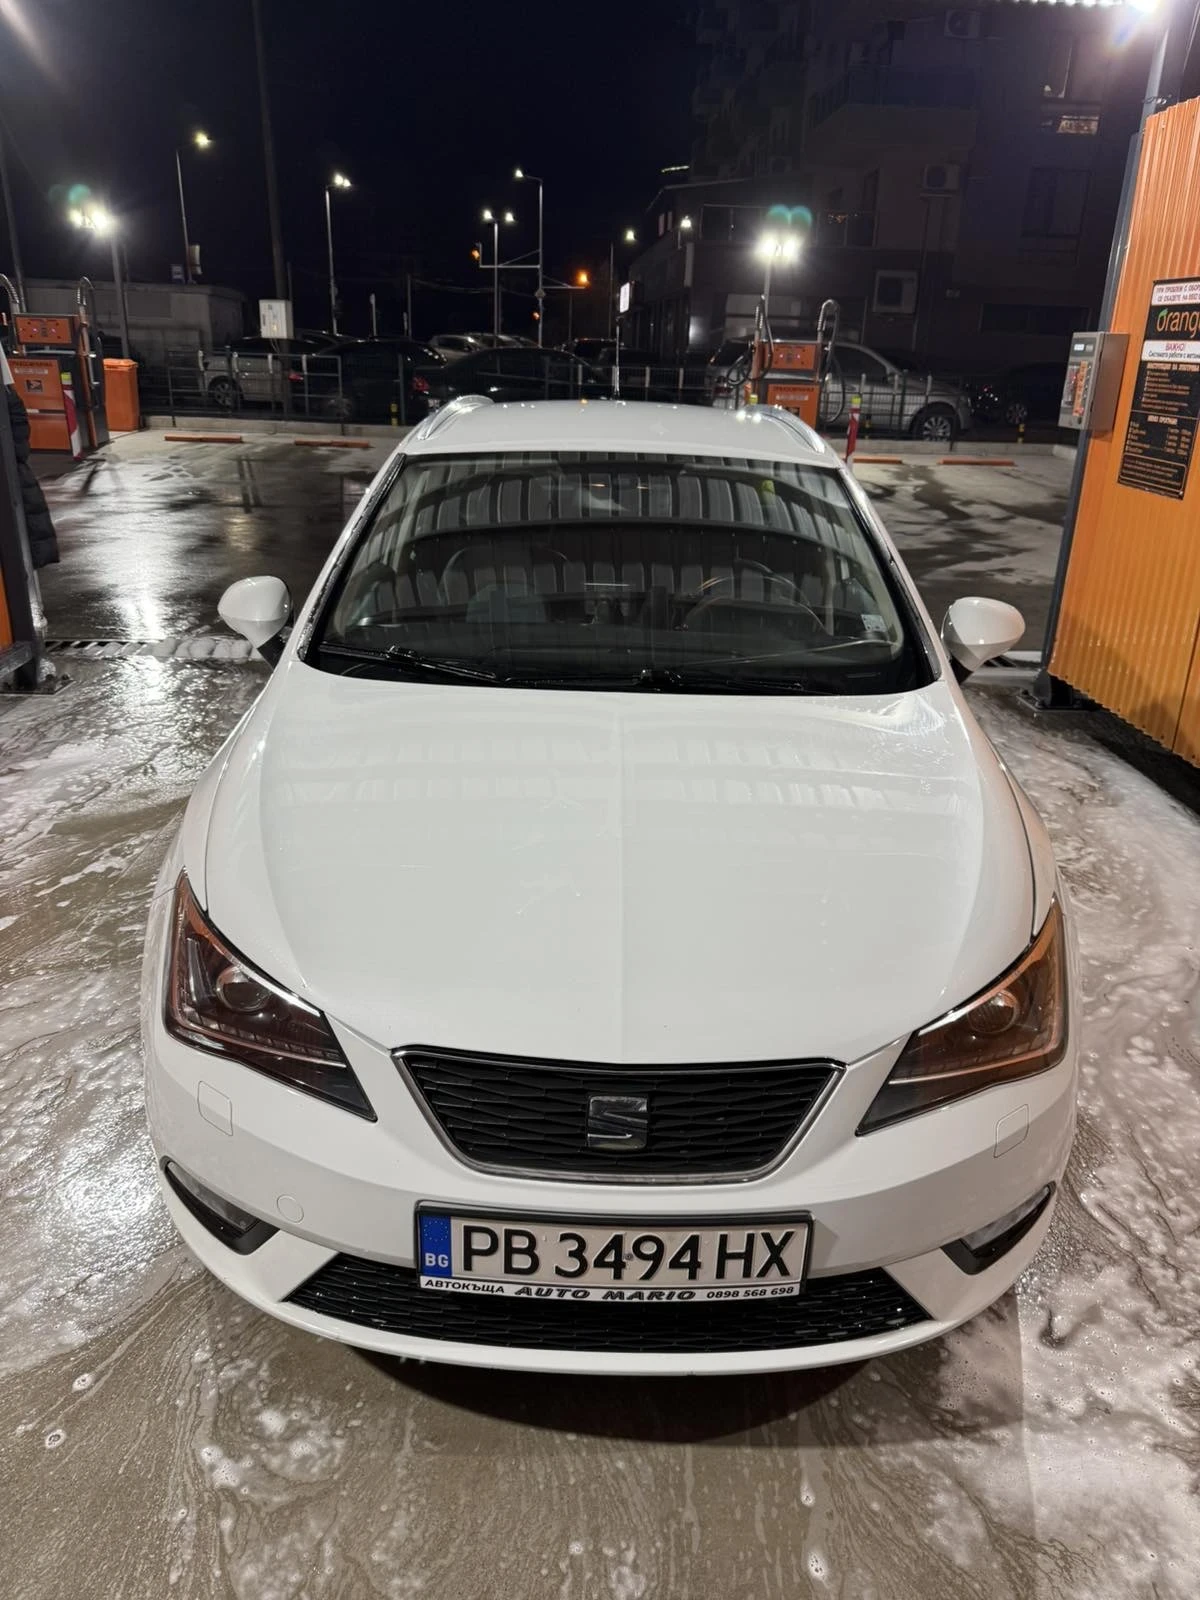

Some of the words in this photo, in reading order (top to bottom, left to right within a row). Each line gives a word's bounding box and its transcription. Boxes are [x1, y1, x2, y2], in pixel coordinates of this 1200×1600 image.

[425, 1253, 449, 1267] BG
[463, 1225, 540, 1276] PB
[554, 1232, 702, 1281] 3494
[715, 1230, 795, 1279] HX
[425, 1279, 505, 1294] АВТОКЪЩА
[515, 1287, 591, 1299] AUTO
[602, 1290, 697, 1301] MARIO
[706, 1289, 739, 1299] 0898
[742, 1288, 767, 1298] 568
[770, 1286, 794, 1296] 698
